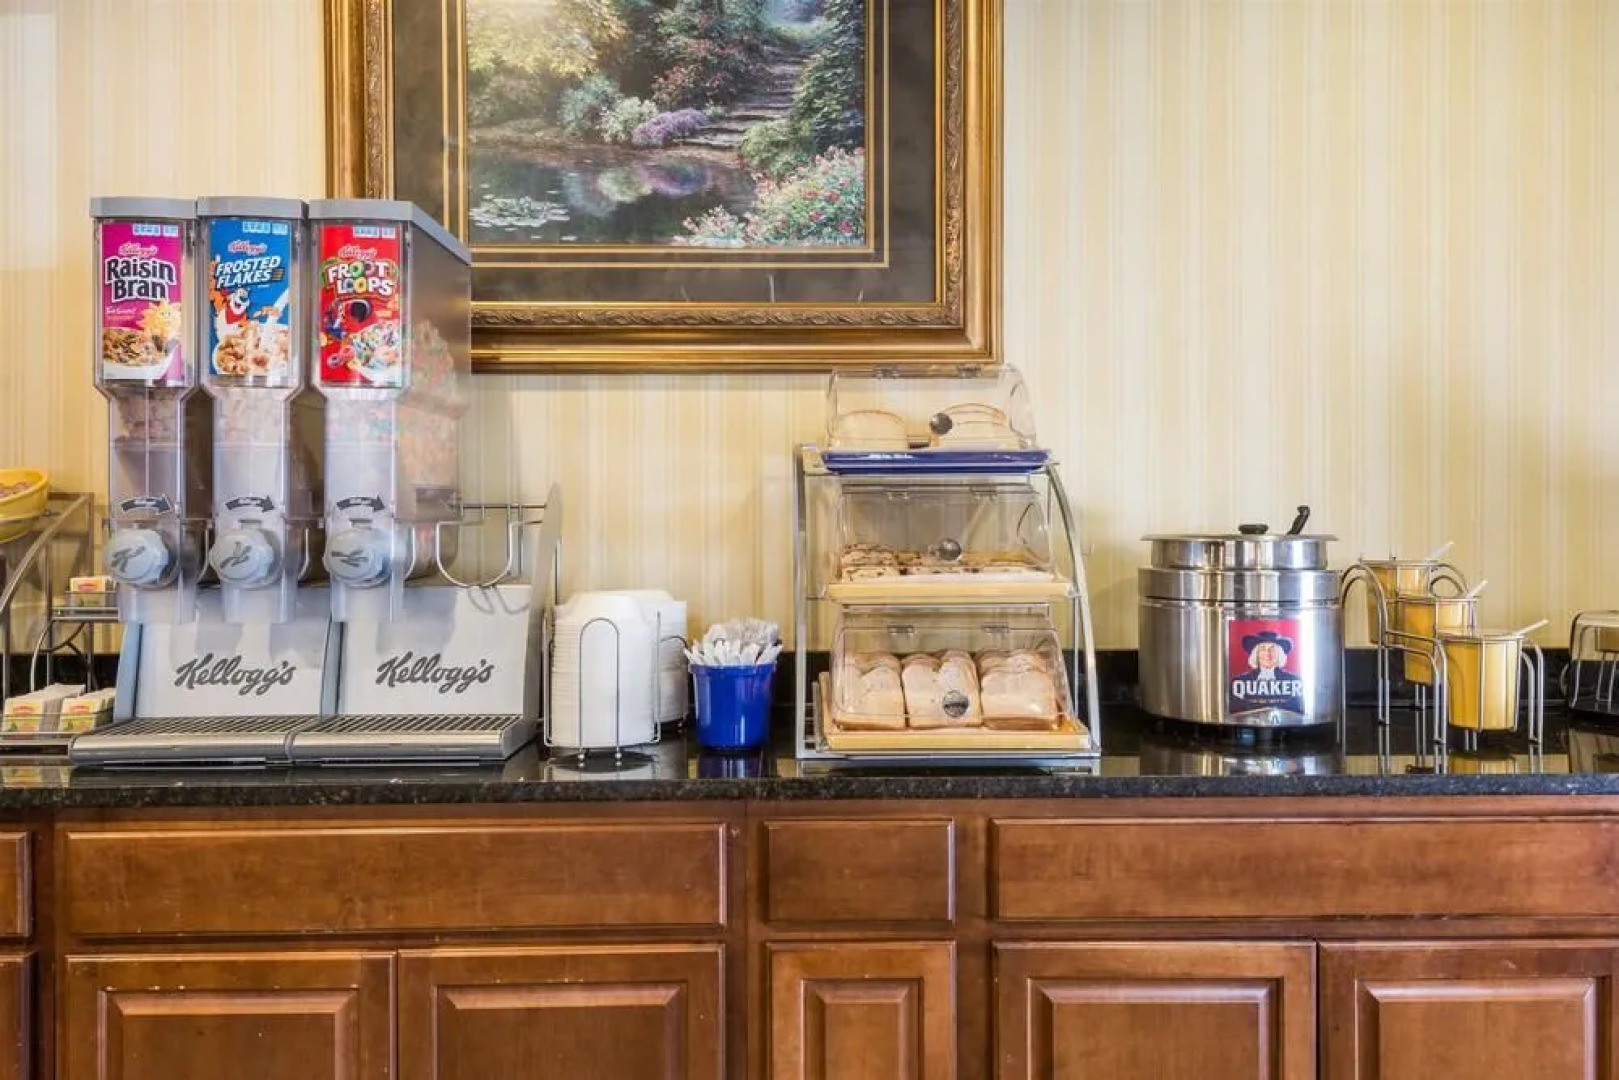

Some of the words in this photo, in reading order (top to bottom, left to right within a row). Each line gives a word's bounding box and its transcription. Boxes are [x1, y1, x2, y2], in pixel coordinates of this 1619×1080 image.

[106, 258, 175, 284] Raisin
[216, 255, 281, 277] FROSTED
[328, 260, 390, 283] FROOT
[113, 279, 167, 301] Bran
[217, 269, 273, 289] FLAKES
[336, 277, 395, 296] LOOPS
[174, 652, 297, 696] Kellogg's
[375, 651, 495, 694] Kellogg's
[1232, 679, 1303, 699] QUAKER
